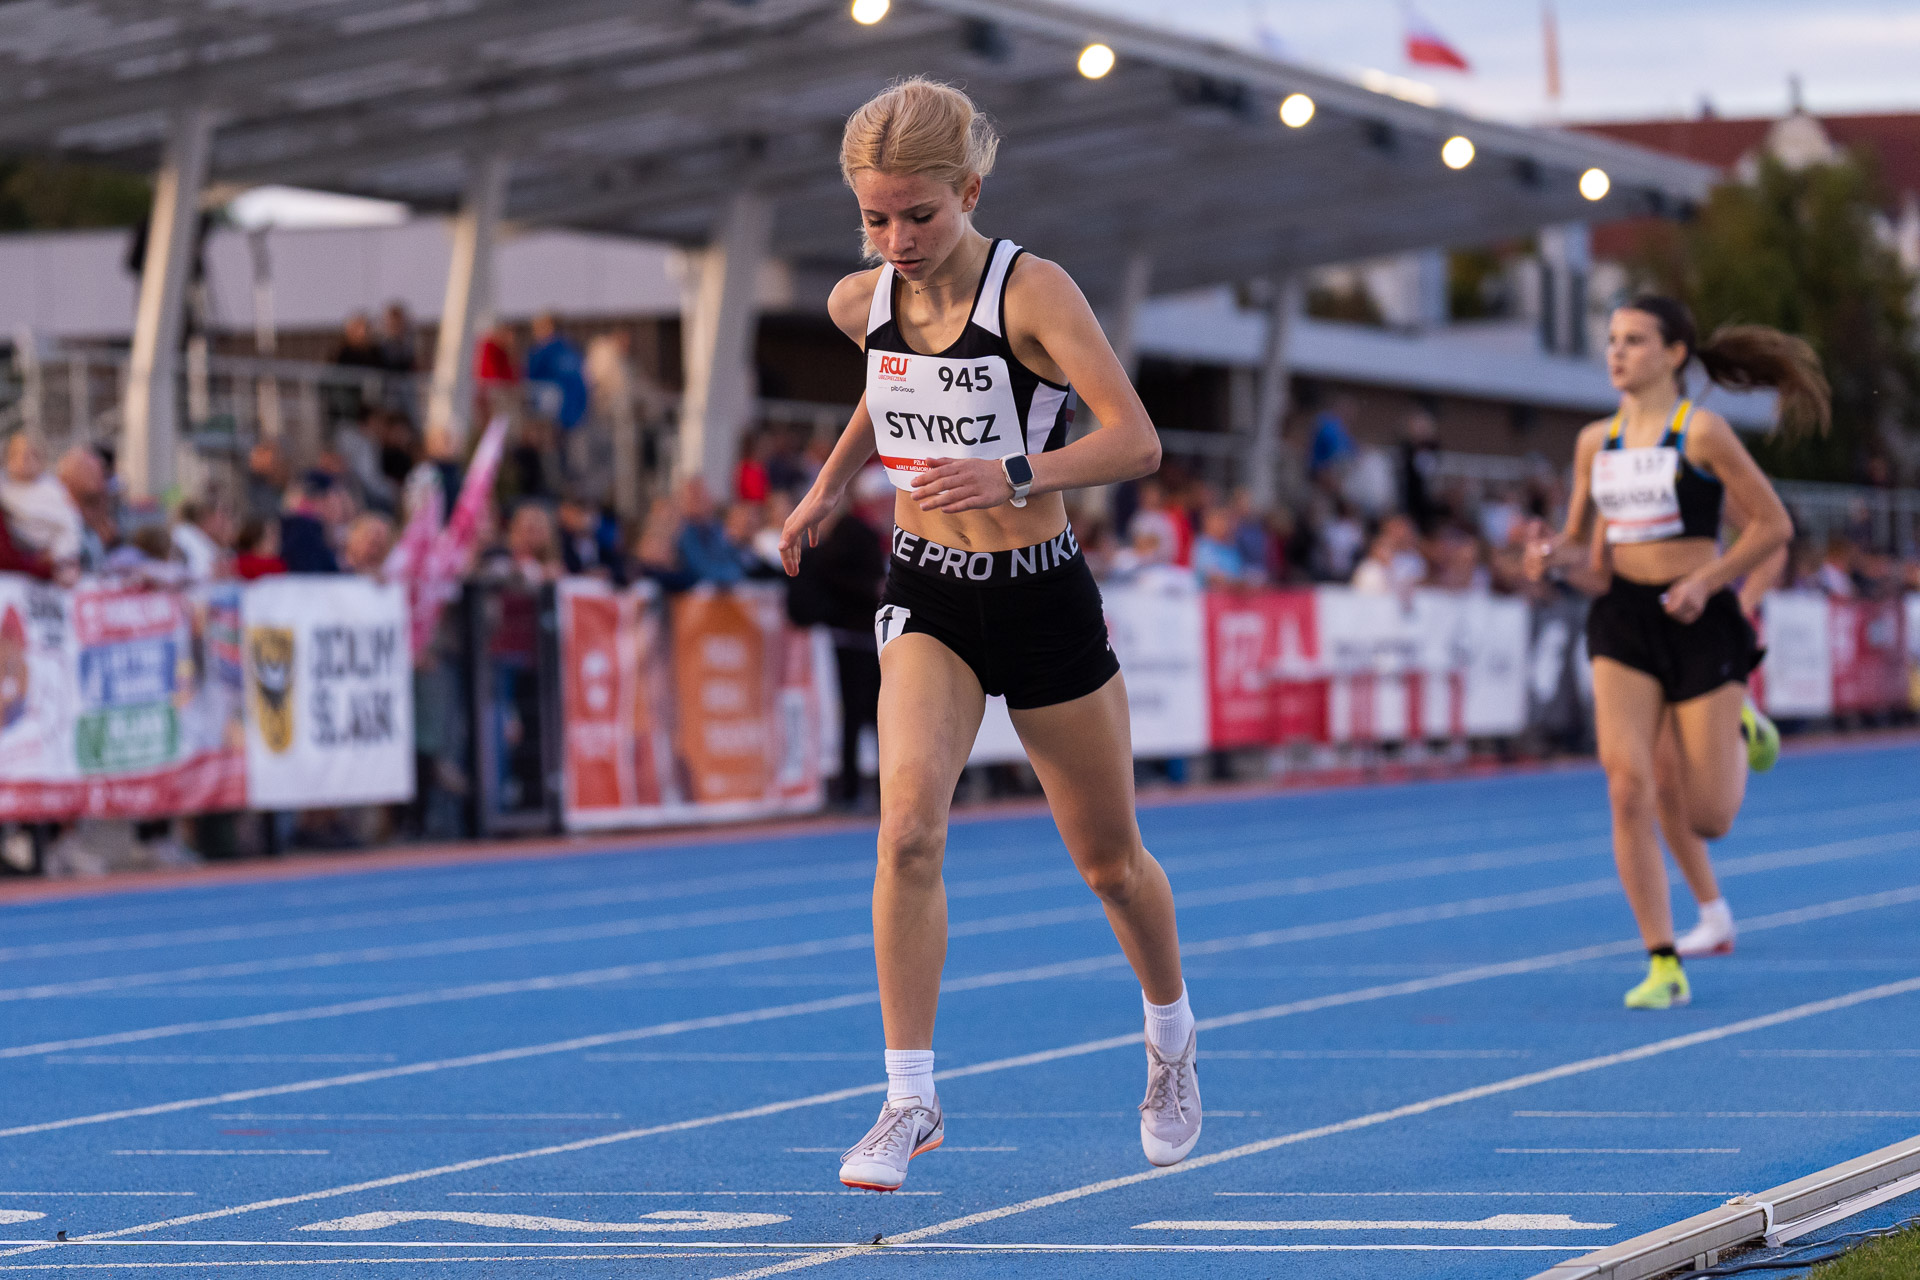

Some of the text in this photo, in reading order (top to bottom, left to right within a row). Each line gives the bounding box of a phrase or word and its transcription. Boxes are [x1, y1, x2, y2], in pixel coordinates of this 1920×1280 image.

[879, 355, 909, 376] RCU
[938, 365, 993, 393] 945
[885, 411, 1001, 446] STYRCZ
[918, 540, 994, 581] PRO
[1010, 521, 1079, 578] NIKE
[291, 1210, 793, 1232] 2
